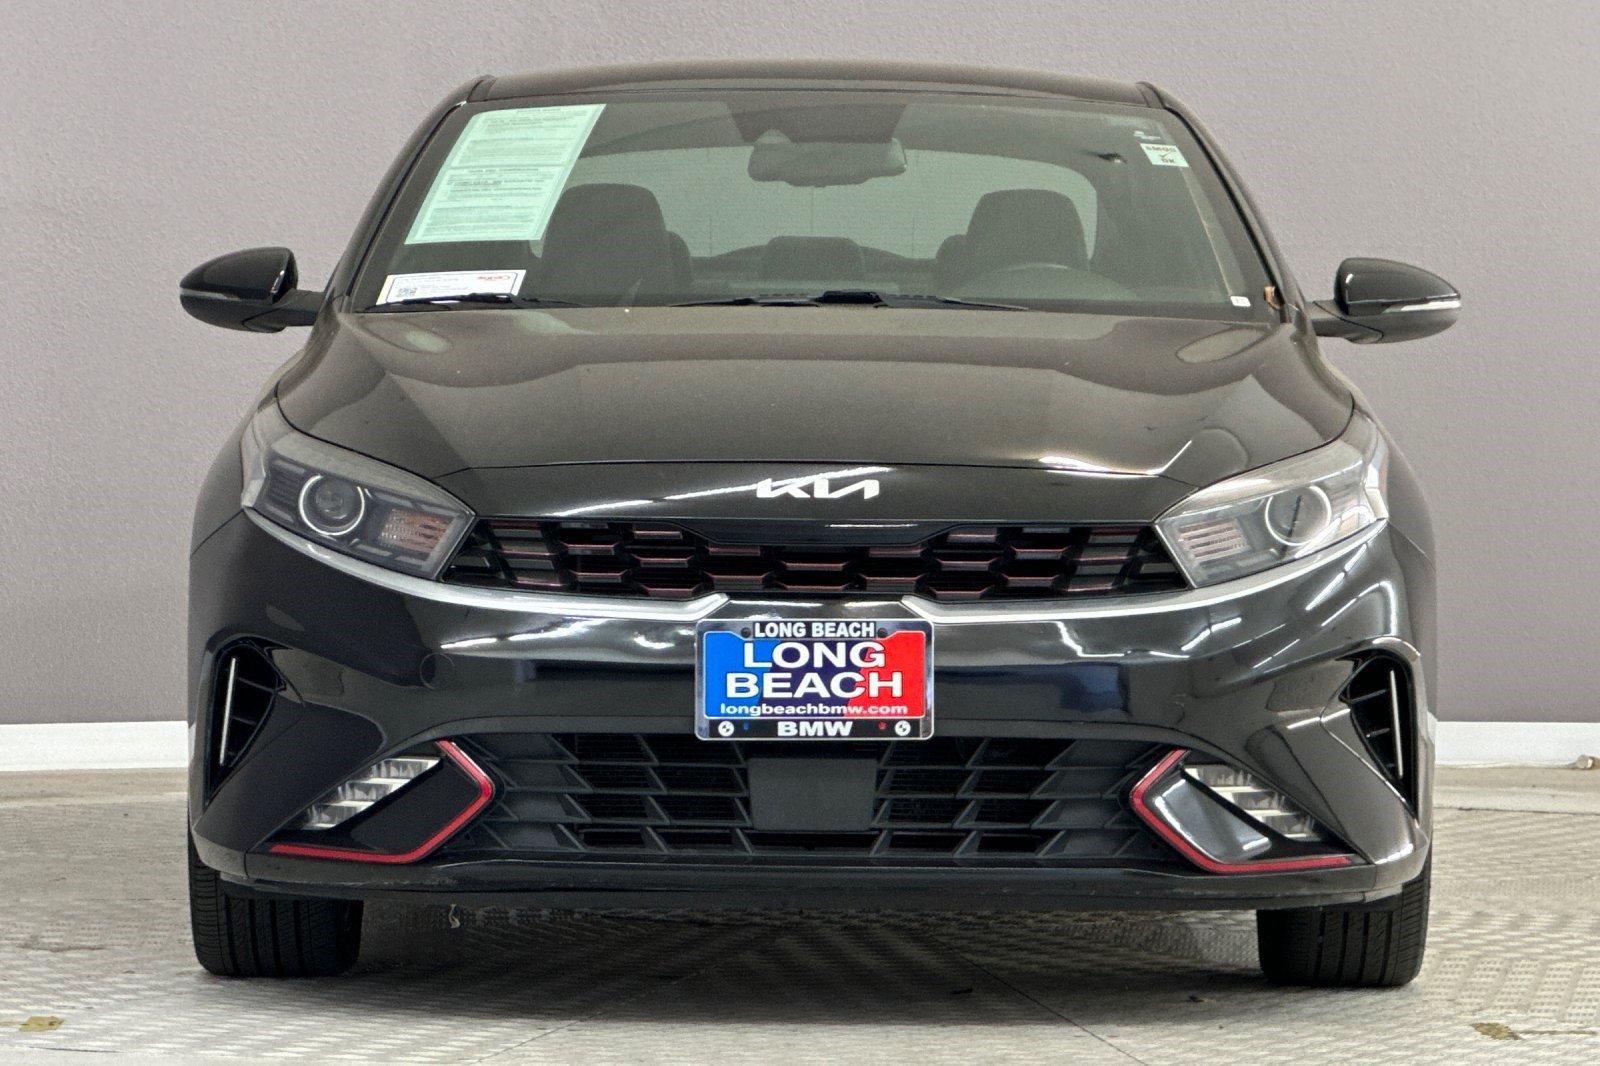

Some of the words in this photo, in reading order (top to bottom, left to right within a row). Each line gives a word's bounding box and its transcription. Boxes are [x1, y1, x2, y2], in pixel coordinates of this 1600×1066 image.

[754, 622, 806, 638] LONG
[812, 622, 875, 638] BEACH
[743, 641, 886, 669] LONG
[726, 672, 903, 699] BEACH
[720, 703, 909, 717] longbeachbmw.com
[777, 721, 854, 737] BMW
